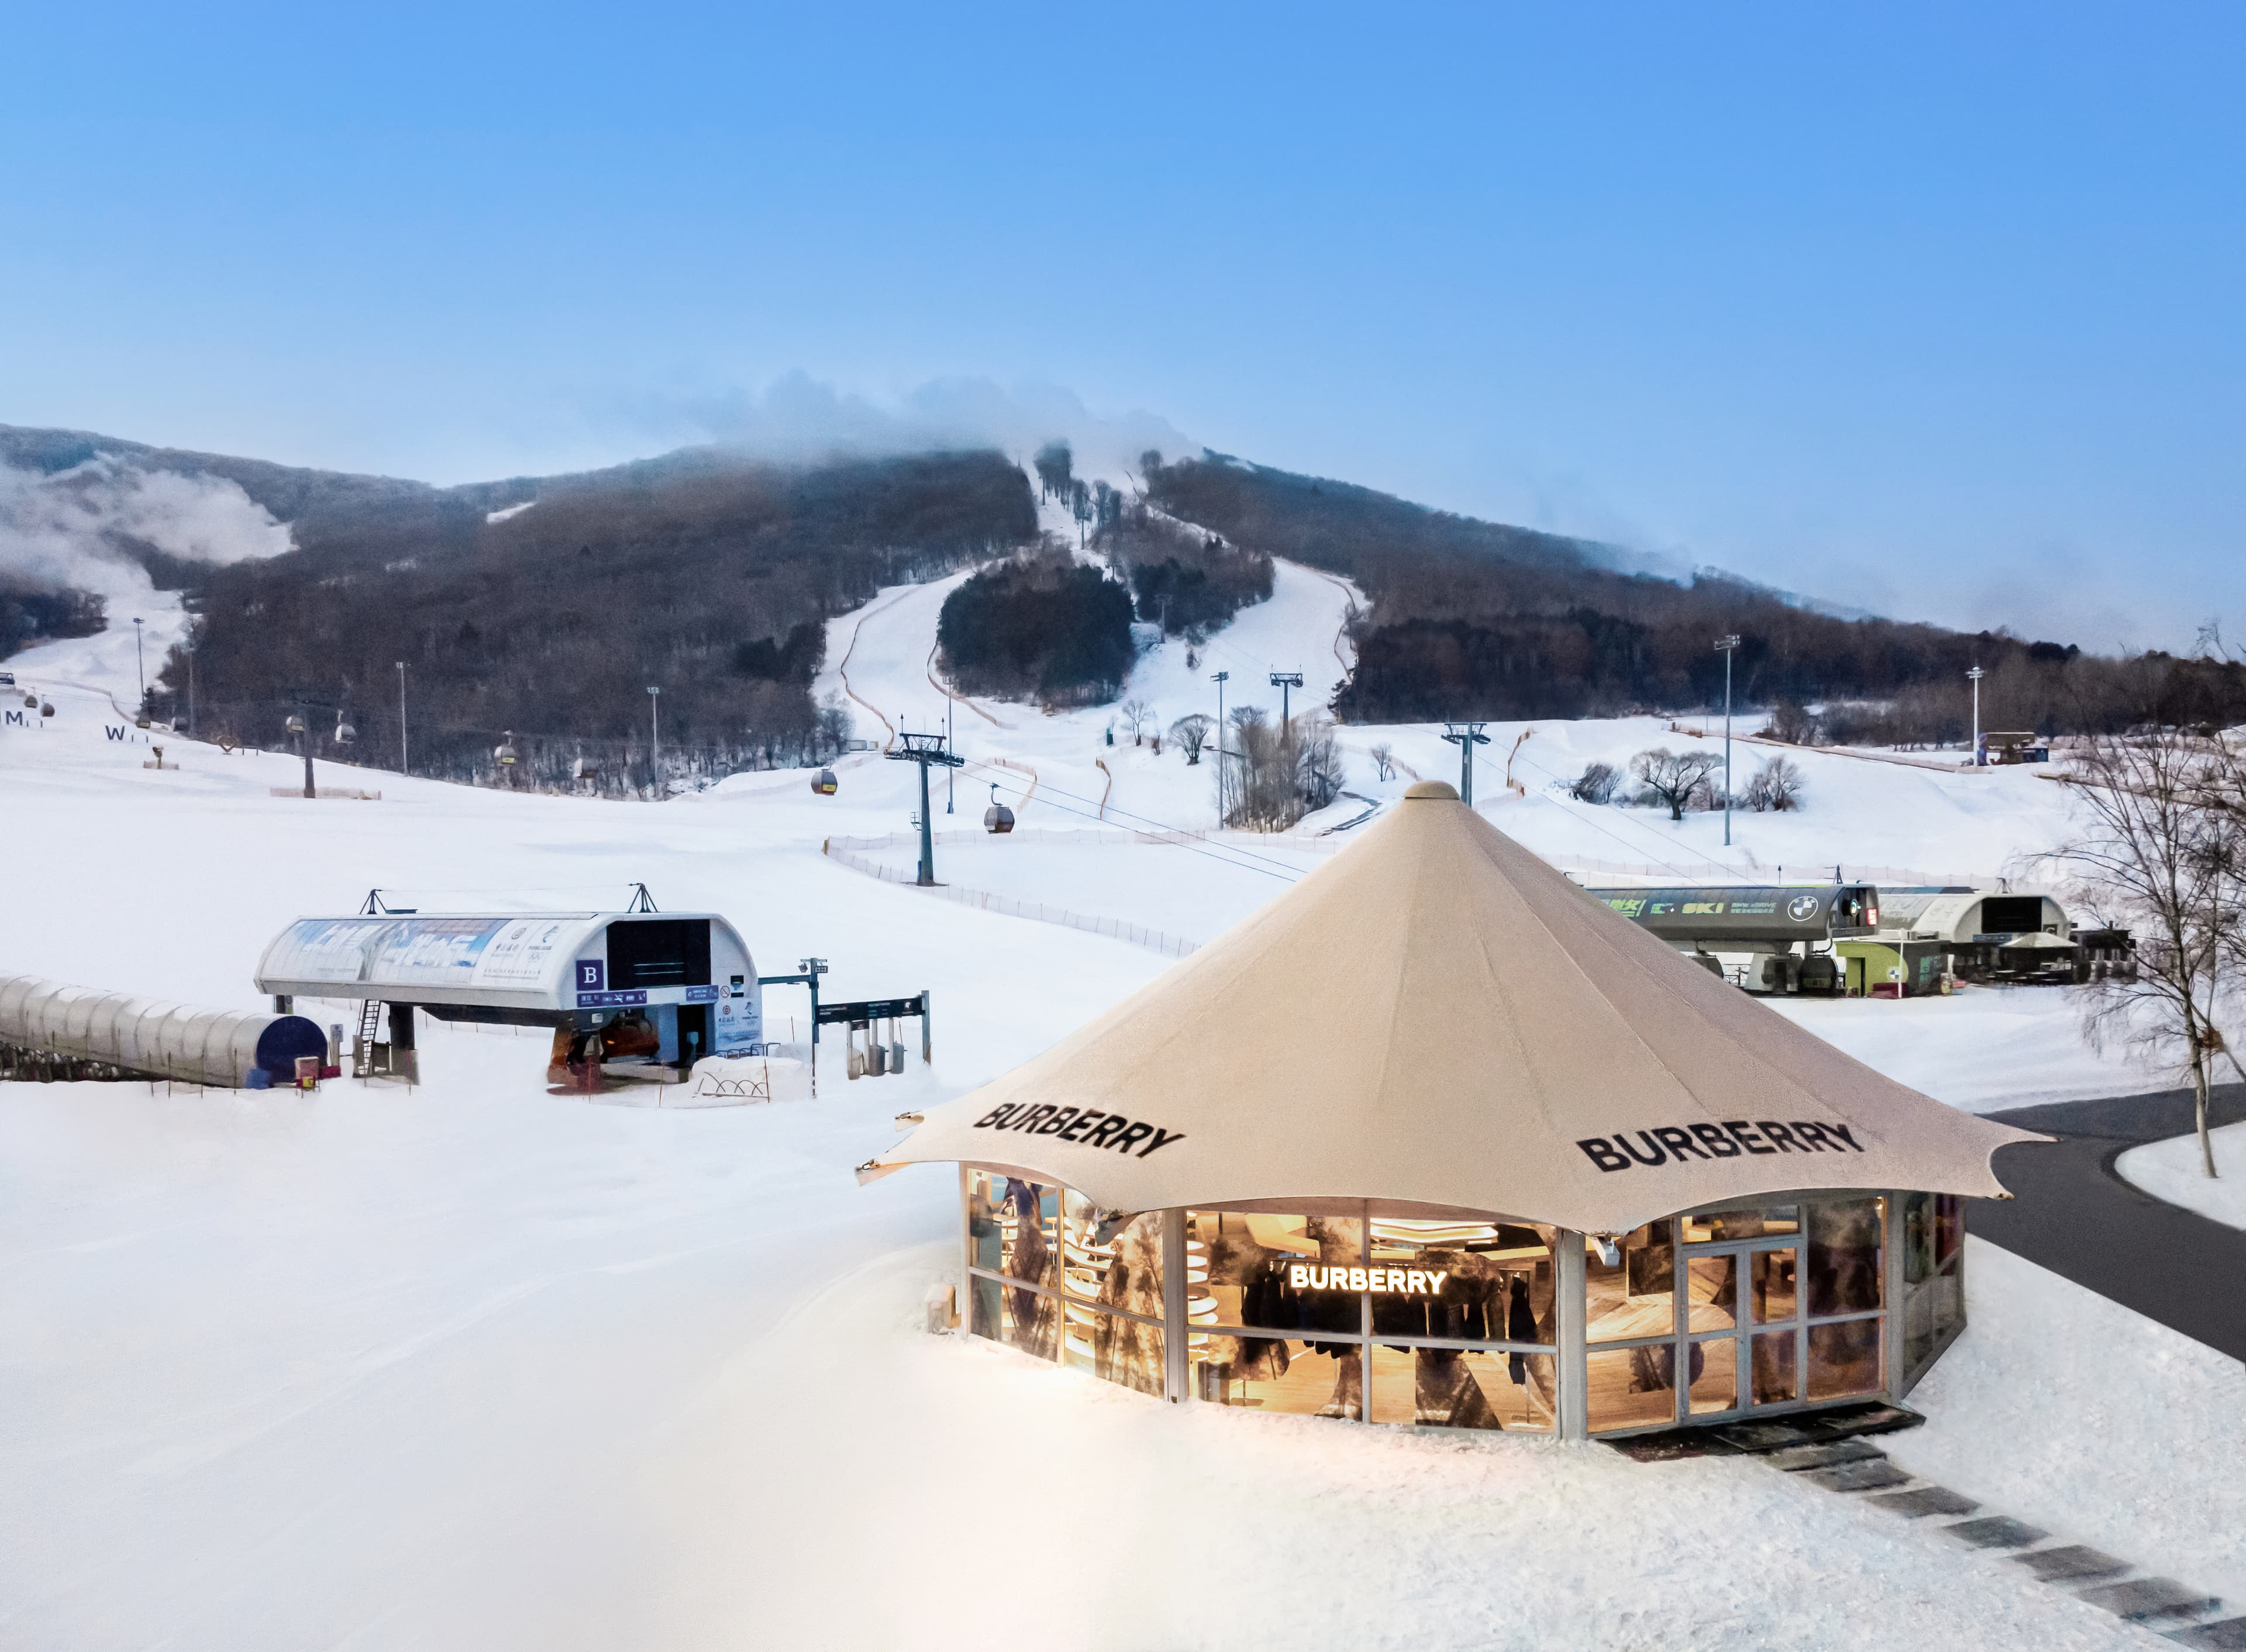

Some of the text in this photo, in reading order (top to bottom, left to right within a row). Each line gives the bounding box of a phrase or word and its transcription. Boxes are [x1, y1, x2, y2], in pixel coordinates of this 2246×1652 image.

[6, 711, 23, 726] M
[105, 725, 125, 740] W
[584, 967, 597, 983] B
[972, 1103, 1187, 1159] BURBERRY
[1576, 1120, 1865, 1172] BURBERRY
[1290, 1265, 1448, 1295] BURBERRY
